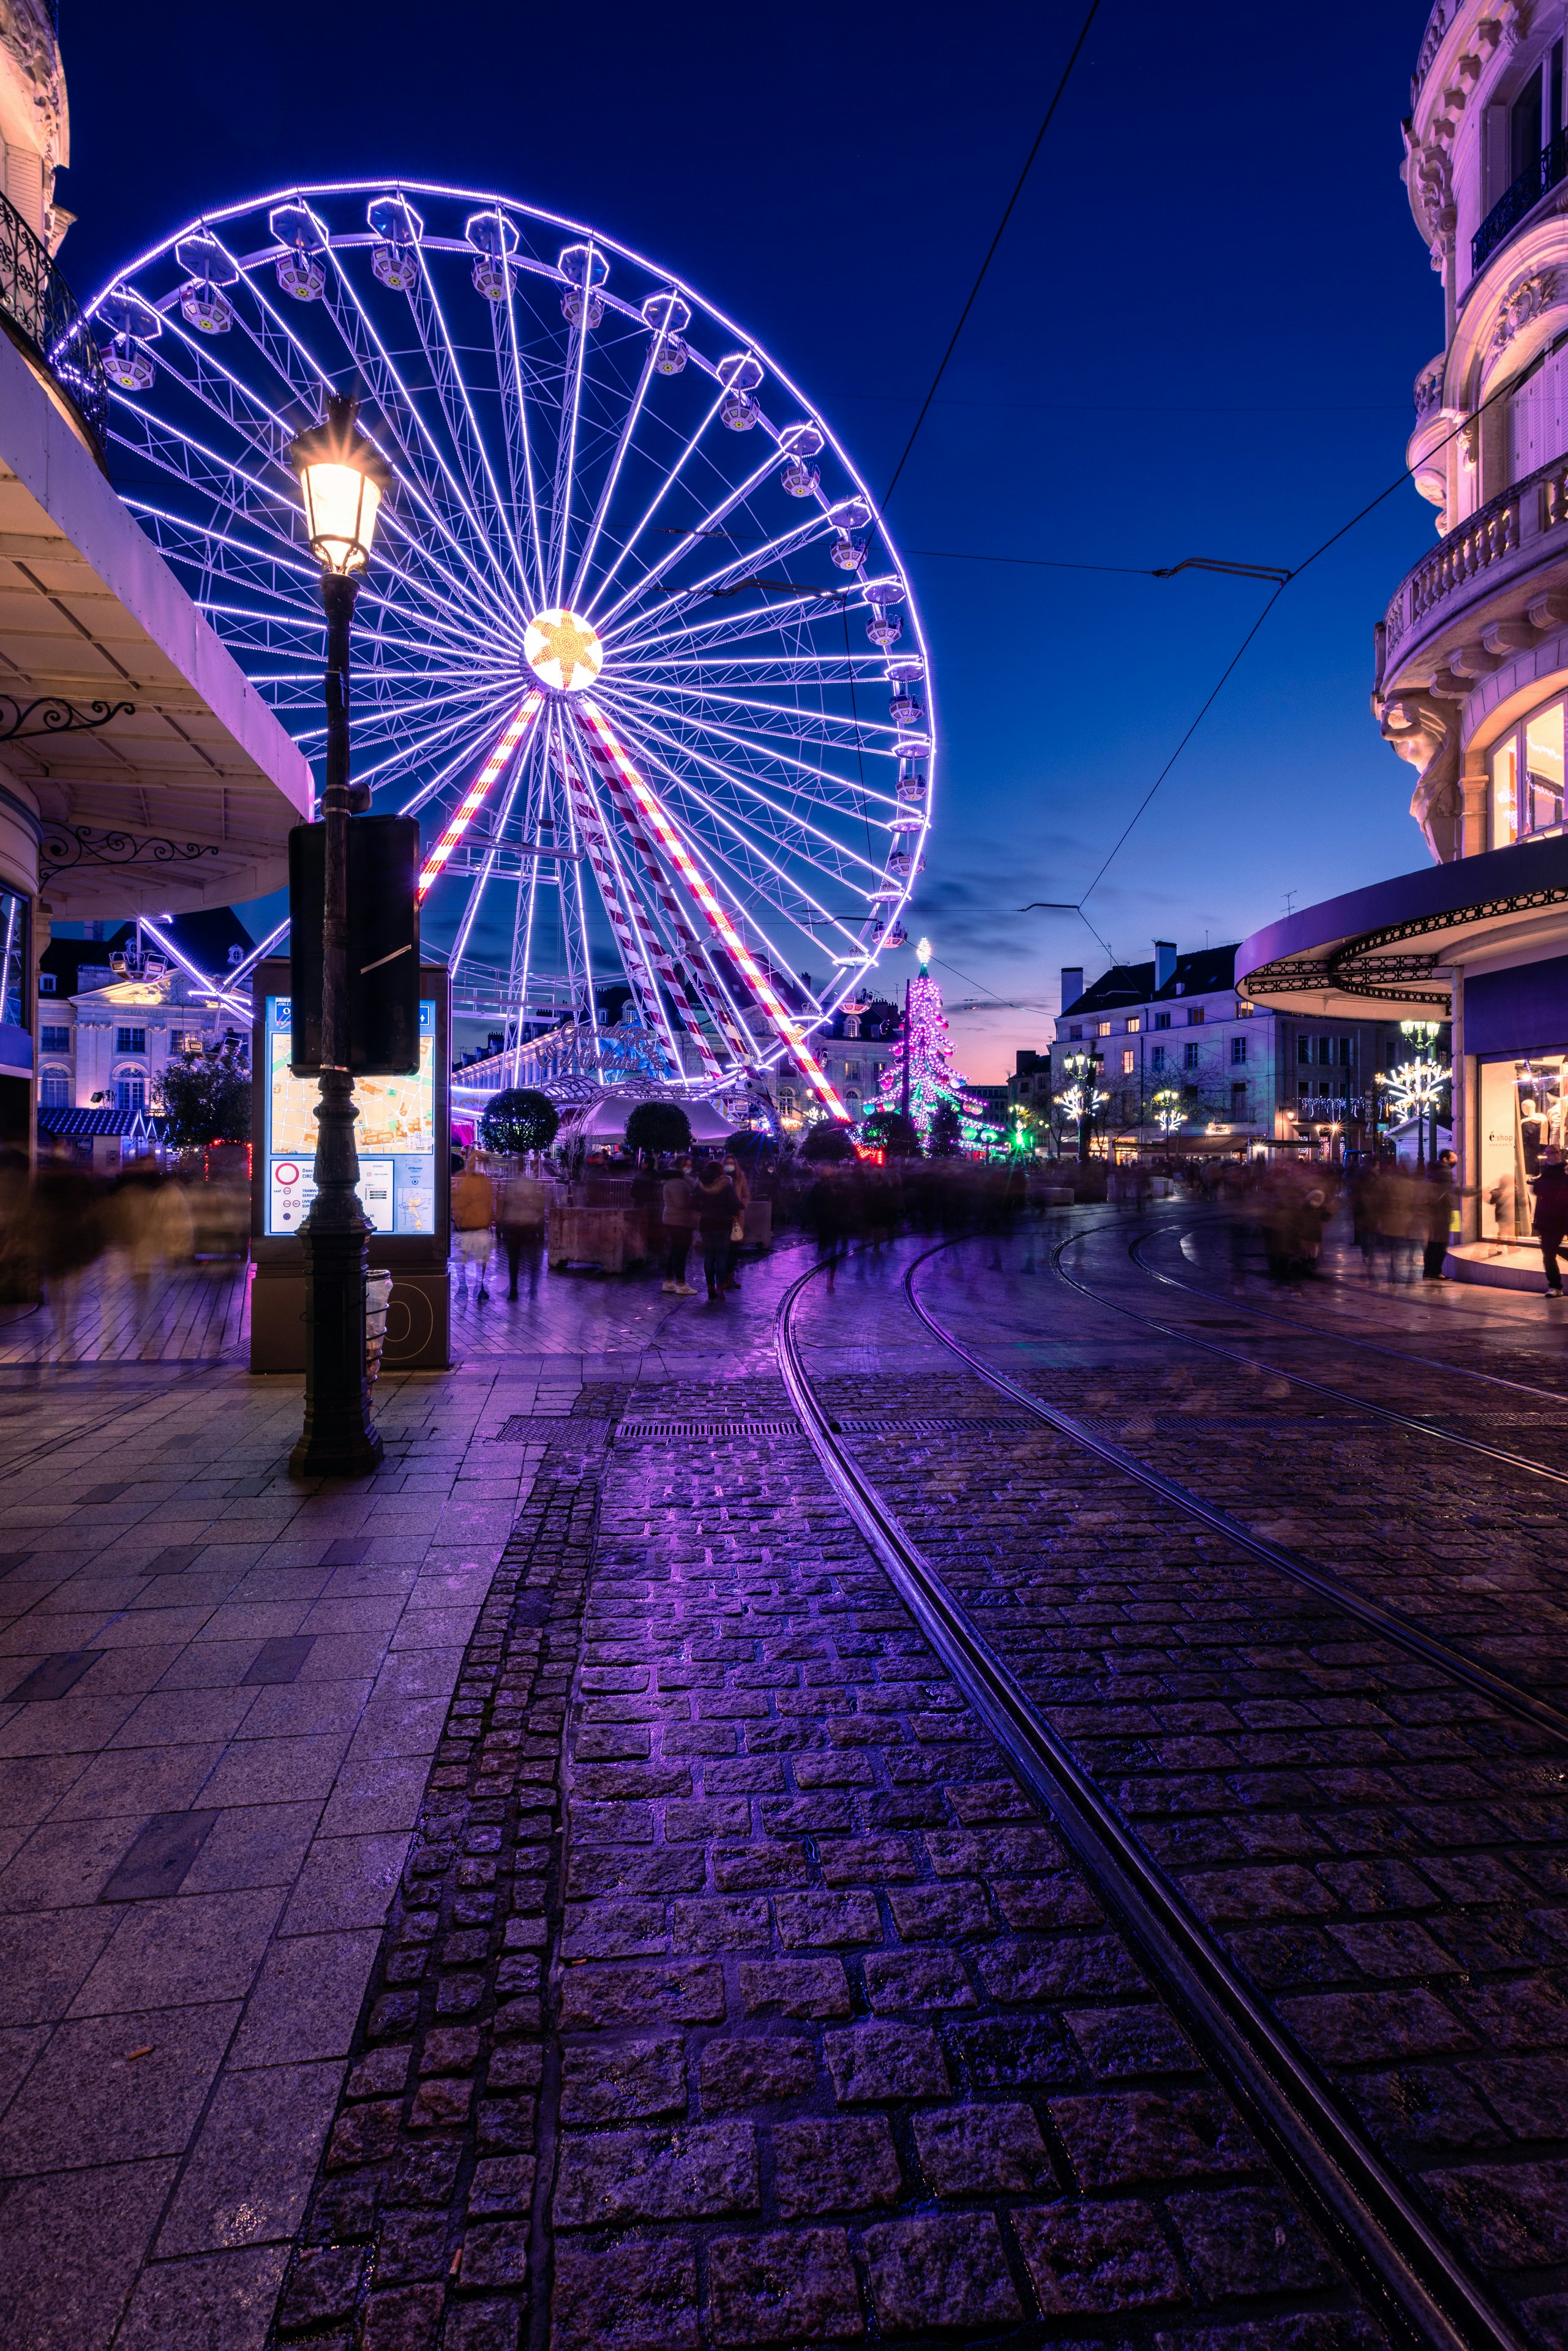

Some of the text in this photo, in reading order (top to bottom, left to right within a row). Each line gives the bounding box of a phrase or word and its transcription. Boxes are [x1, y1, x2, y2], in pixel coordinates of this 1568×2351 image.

[560, 1020, 626, 1046] Grande
[628, 1027, 666, 1071] Roue
[1489, 1131, 1513, 1142] é-shop
